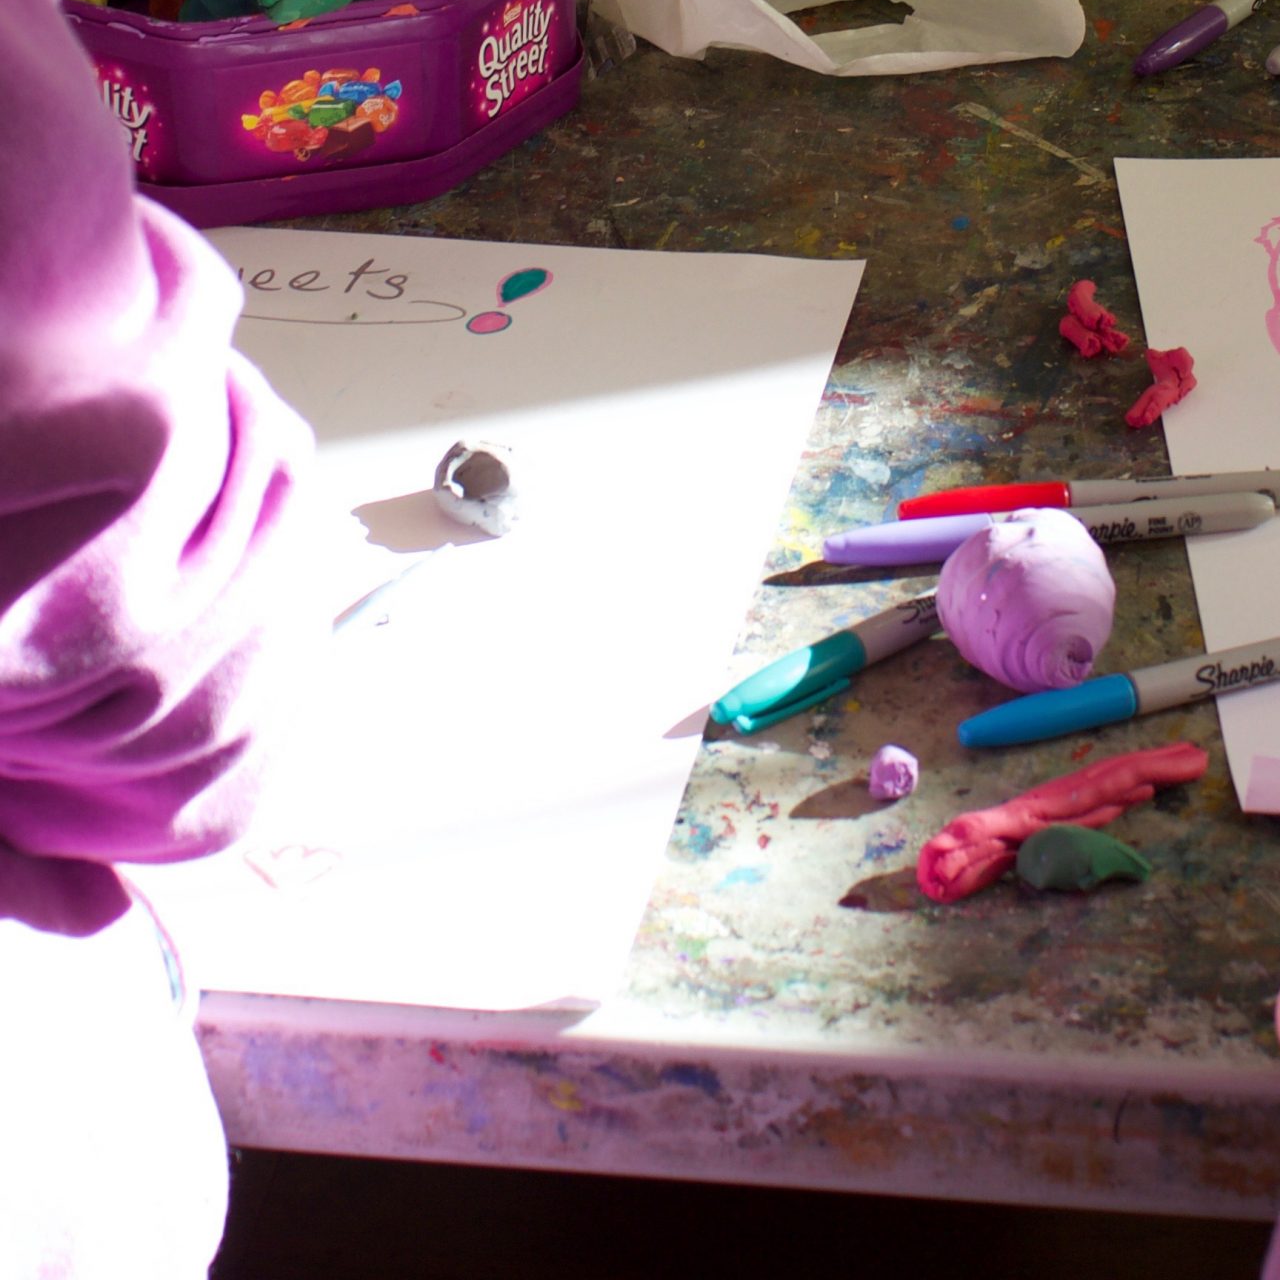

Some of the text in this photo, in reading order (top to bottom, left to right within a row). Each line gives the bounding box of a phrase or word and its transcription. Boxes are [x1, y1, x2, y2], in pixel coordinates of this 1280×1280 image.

[478, 0, 556, 79] Quality
[484, 32, 549, 119] Street
[1090, 517, 1138, 540] arpie
[1190, 655, 1276, 699] Sharpie
